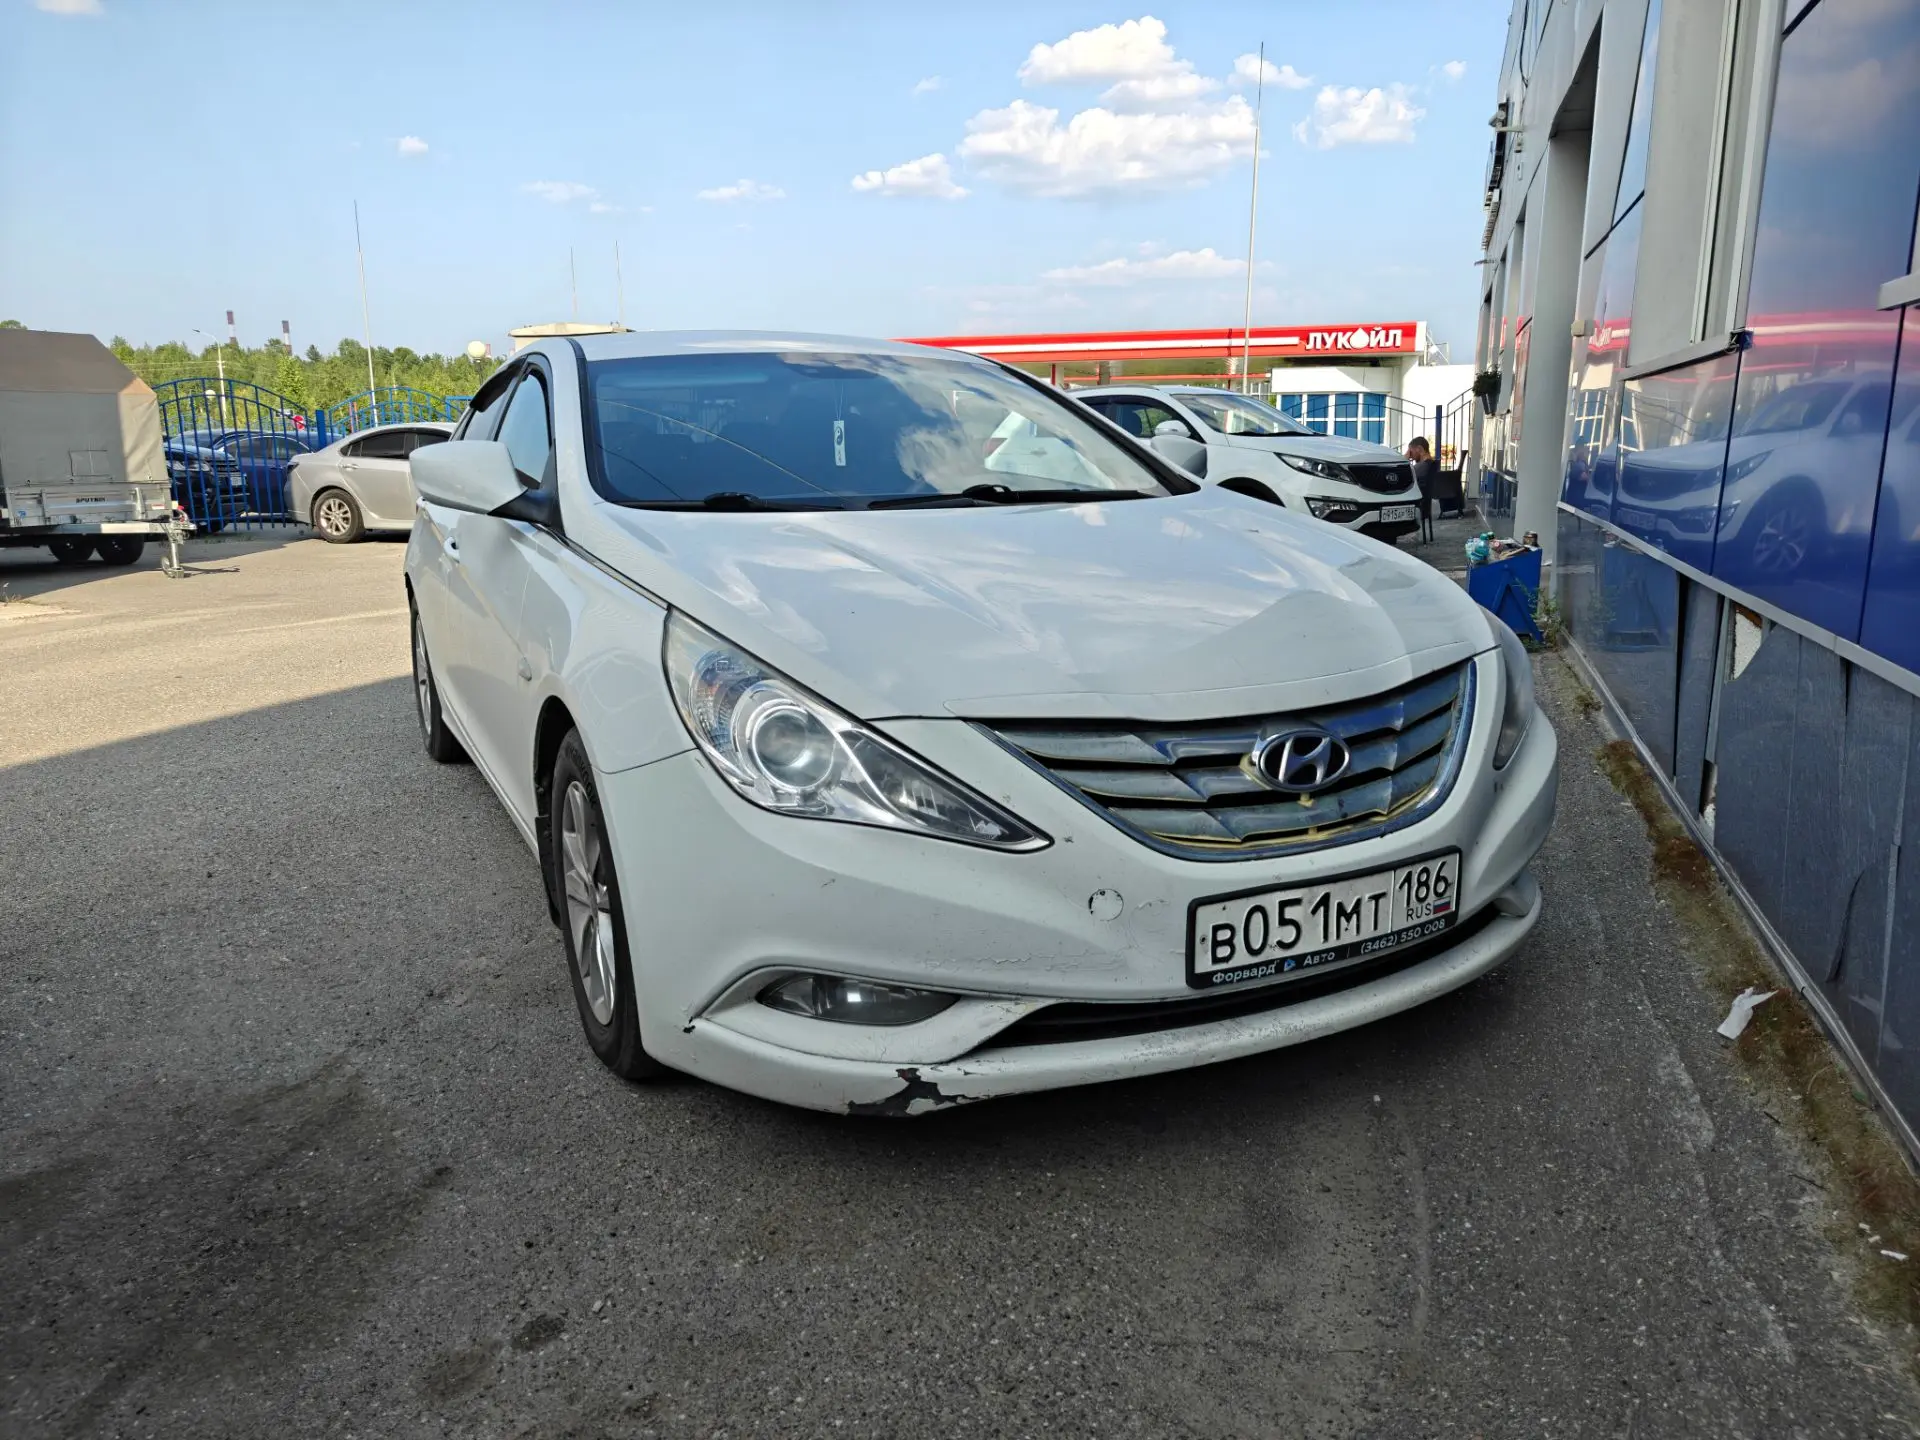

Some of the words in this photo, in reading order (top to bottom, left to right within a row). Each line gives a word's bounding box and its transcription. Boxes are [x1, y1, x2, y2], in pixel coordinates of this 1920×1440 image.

[1305, 326, 1402, 350] ЛУКОЙЛ
[1398, 860, 1448, 908] 186
[1406, 902, 1432, 922] RUS
[1212, 963, 1277, 983] Форвард
[1303, 952, 1336, 967] Авто
[1361, 934, 1398, 954] (3462)
[1400, 927, 1422, 943] 550
[1424, 918, 1446, 935] 008
